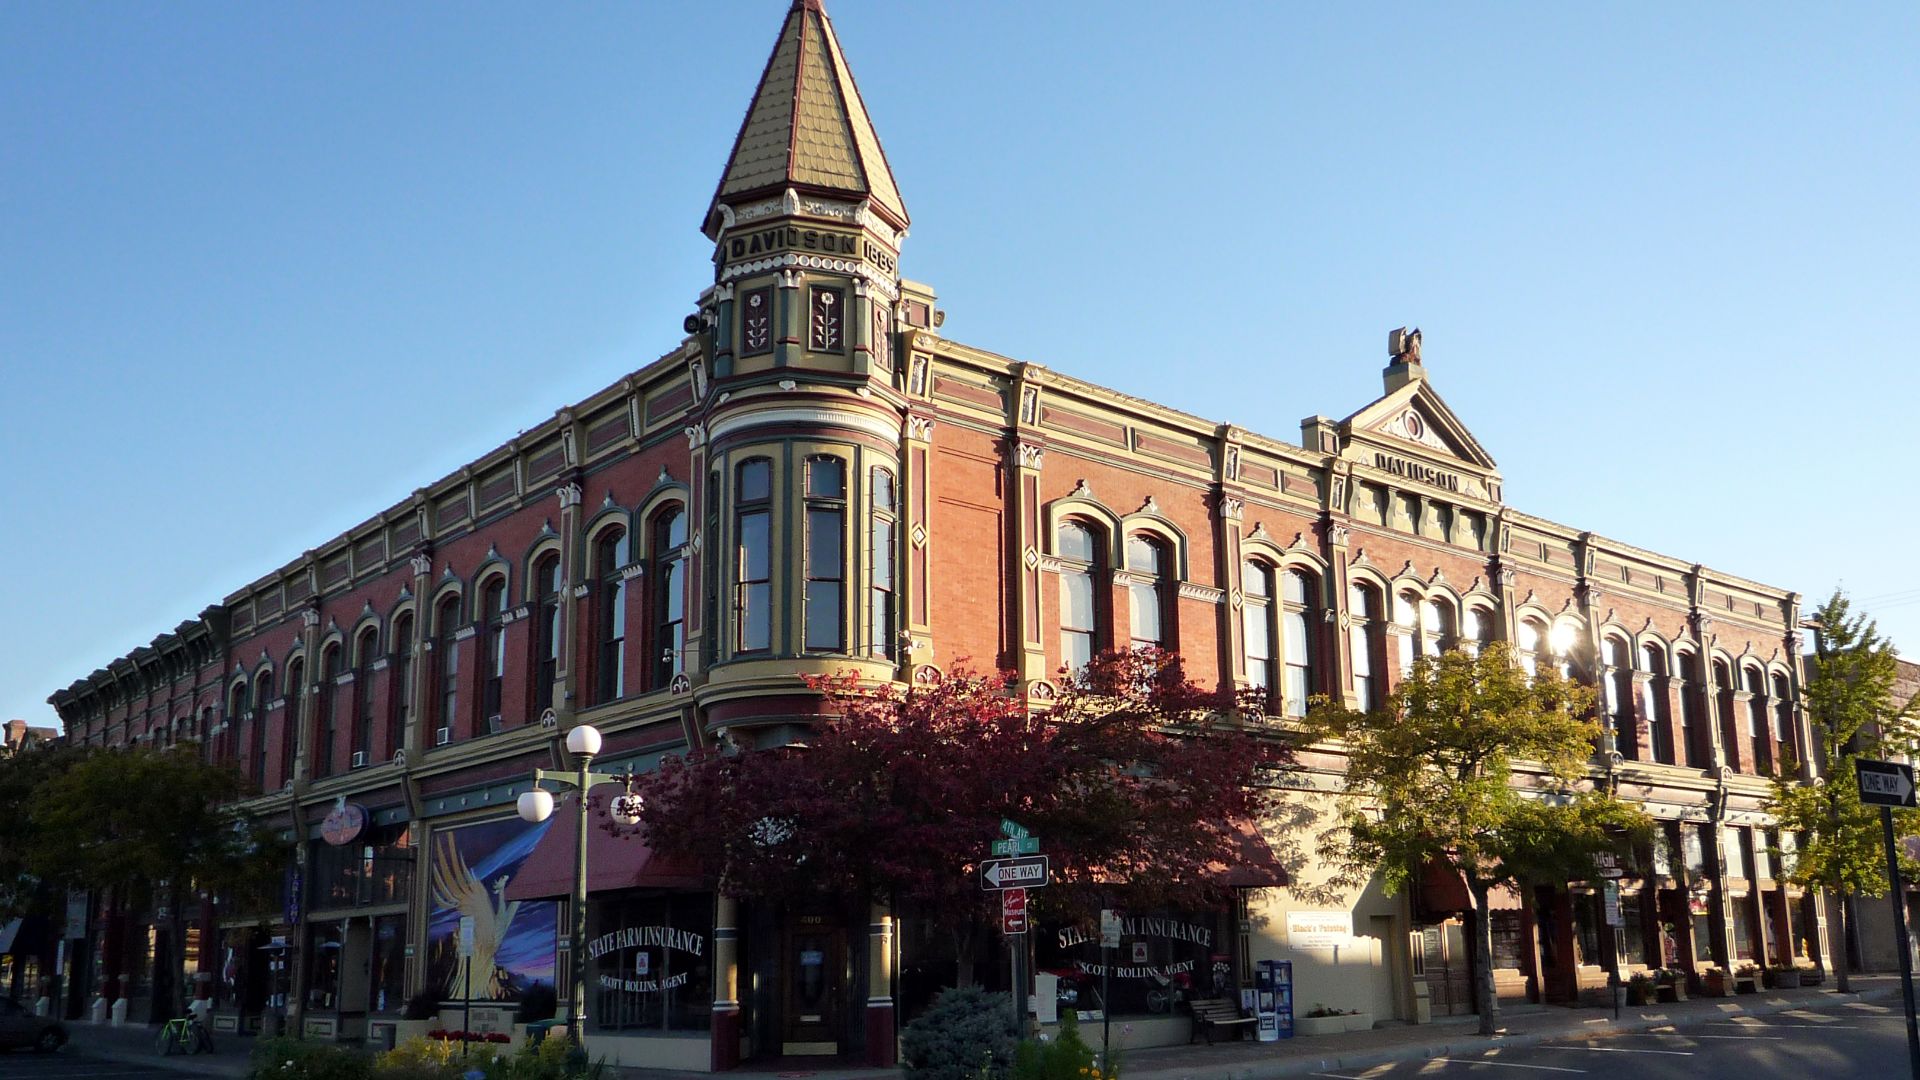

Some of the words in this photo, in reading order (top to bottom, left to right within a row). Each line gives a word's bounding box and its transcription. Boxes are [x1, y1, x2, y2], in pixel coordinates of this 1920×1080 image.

[731, 227, 856, 258] DAVIDSON
[864, 240, 895, 274] 1889
[1374, 453, 1458, 492] DAVIDSON
[1863, 773, 1881, 791] ONE
[1882, 775, 1898, 792] WAY
[1002, 820, 1014, 836] 4TH
[1017, 827, 1029, 840] AVE
[998, 841, 1021, 853] PEARL
[999, 868, 1017, 879] ONE
[1020, 866, 1040, 878] WAY
[589, 932, 615, 960] STATE
[616, 926, 644, 950] FARM
[644, 926, 703, 956] INSURANCE
[1058, 925, 1096, 949] STA
[1141, 917, 1211, 948] INSURANCE
[1164, 959, 1195, 975] AGENT
[600, 974, 623, 990] SCOTT
[662, 972, 688, 989] AGENT
